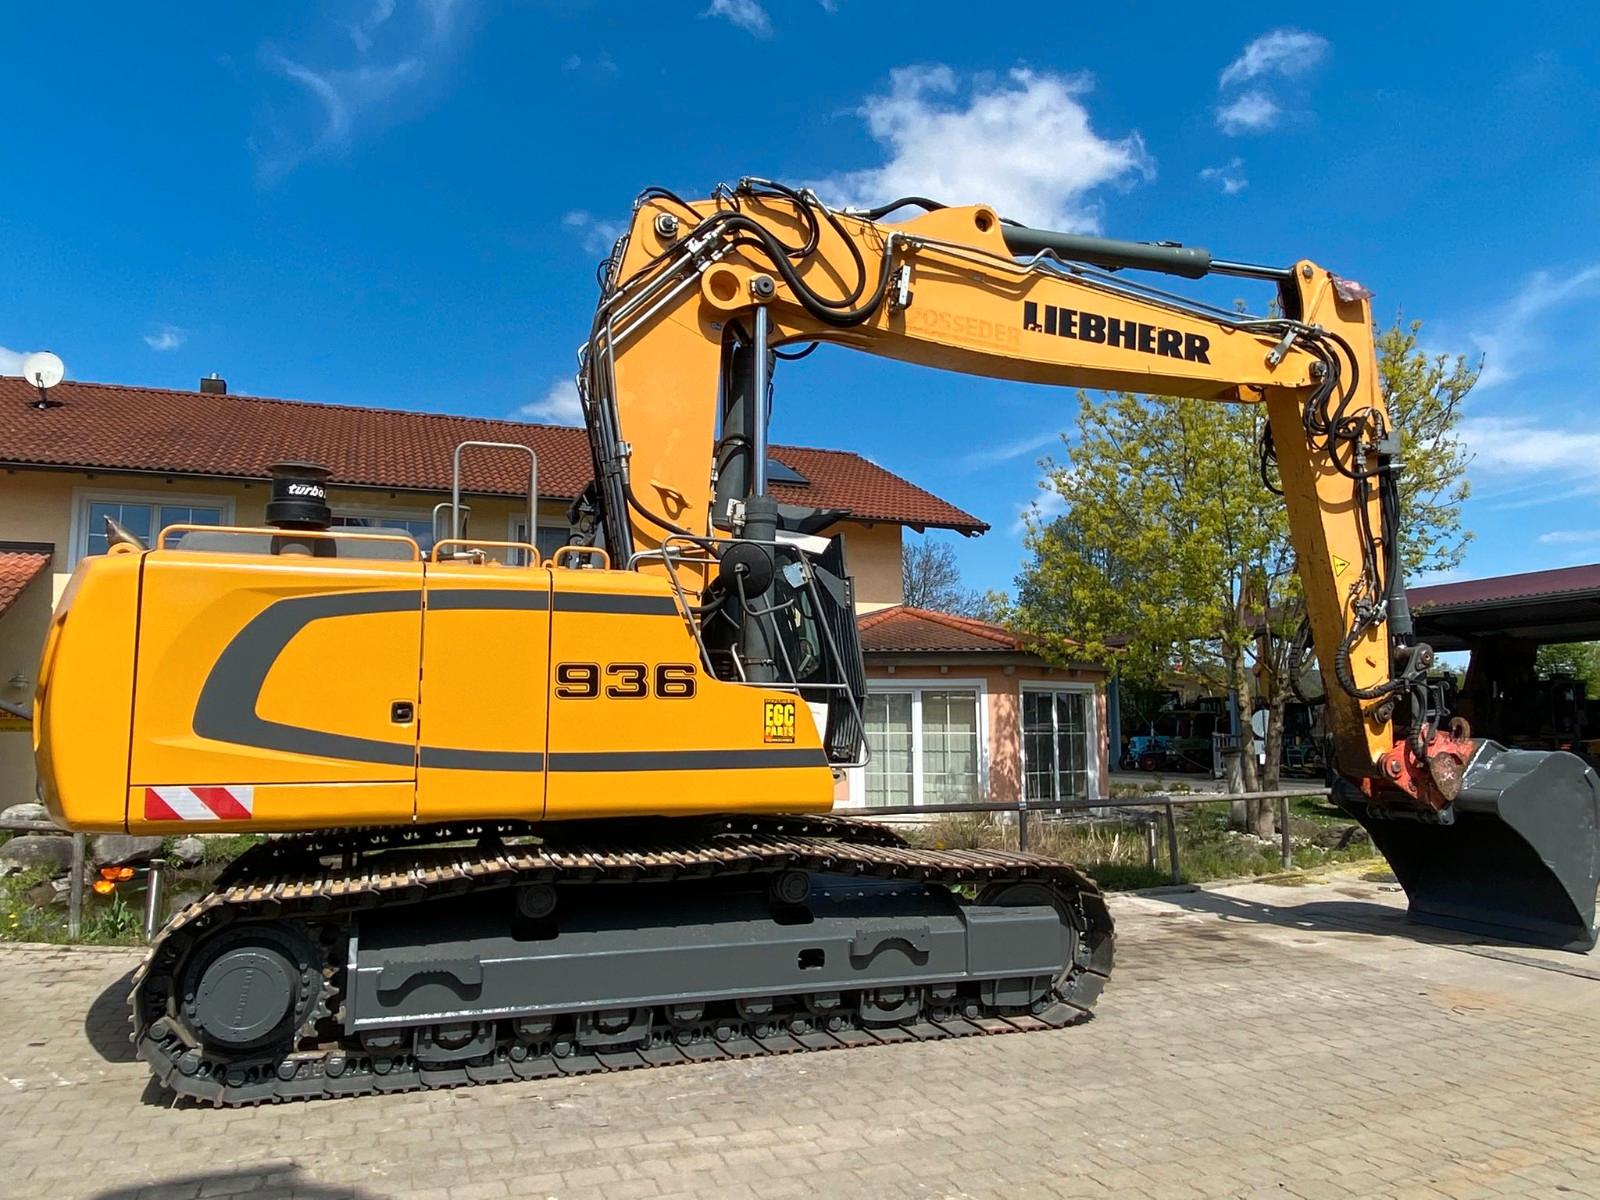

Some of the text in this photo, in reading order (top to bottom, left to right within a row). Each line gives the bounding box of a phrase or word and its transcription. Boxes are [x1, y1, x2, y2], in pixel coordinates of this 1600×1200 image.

[1023, 300, 1211, 365] LIEBHERR
[555, 662, 696, 700] 936
[765, 726, 794, 737] PARTS
